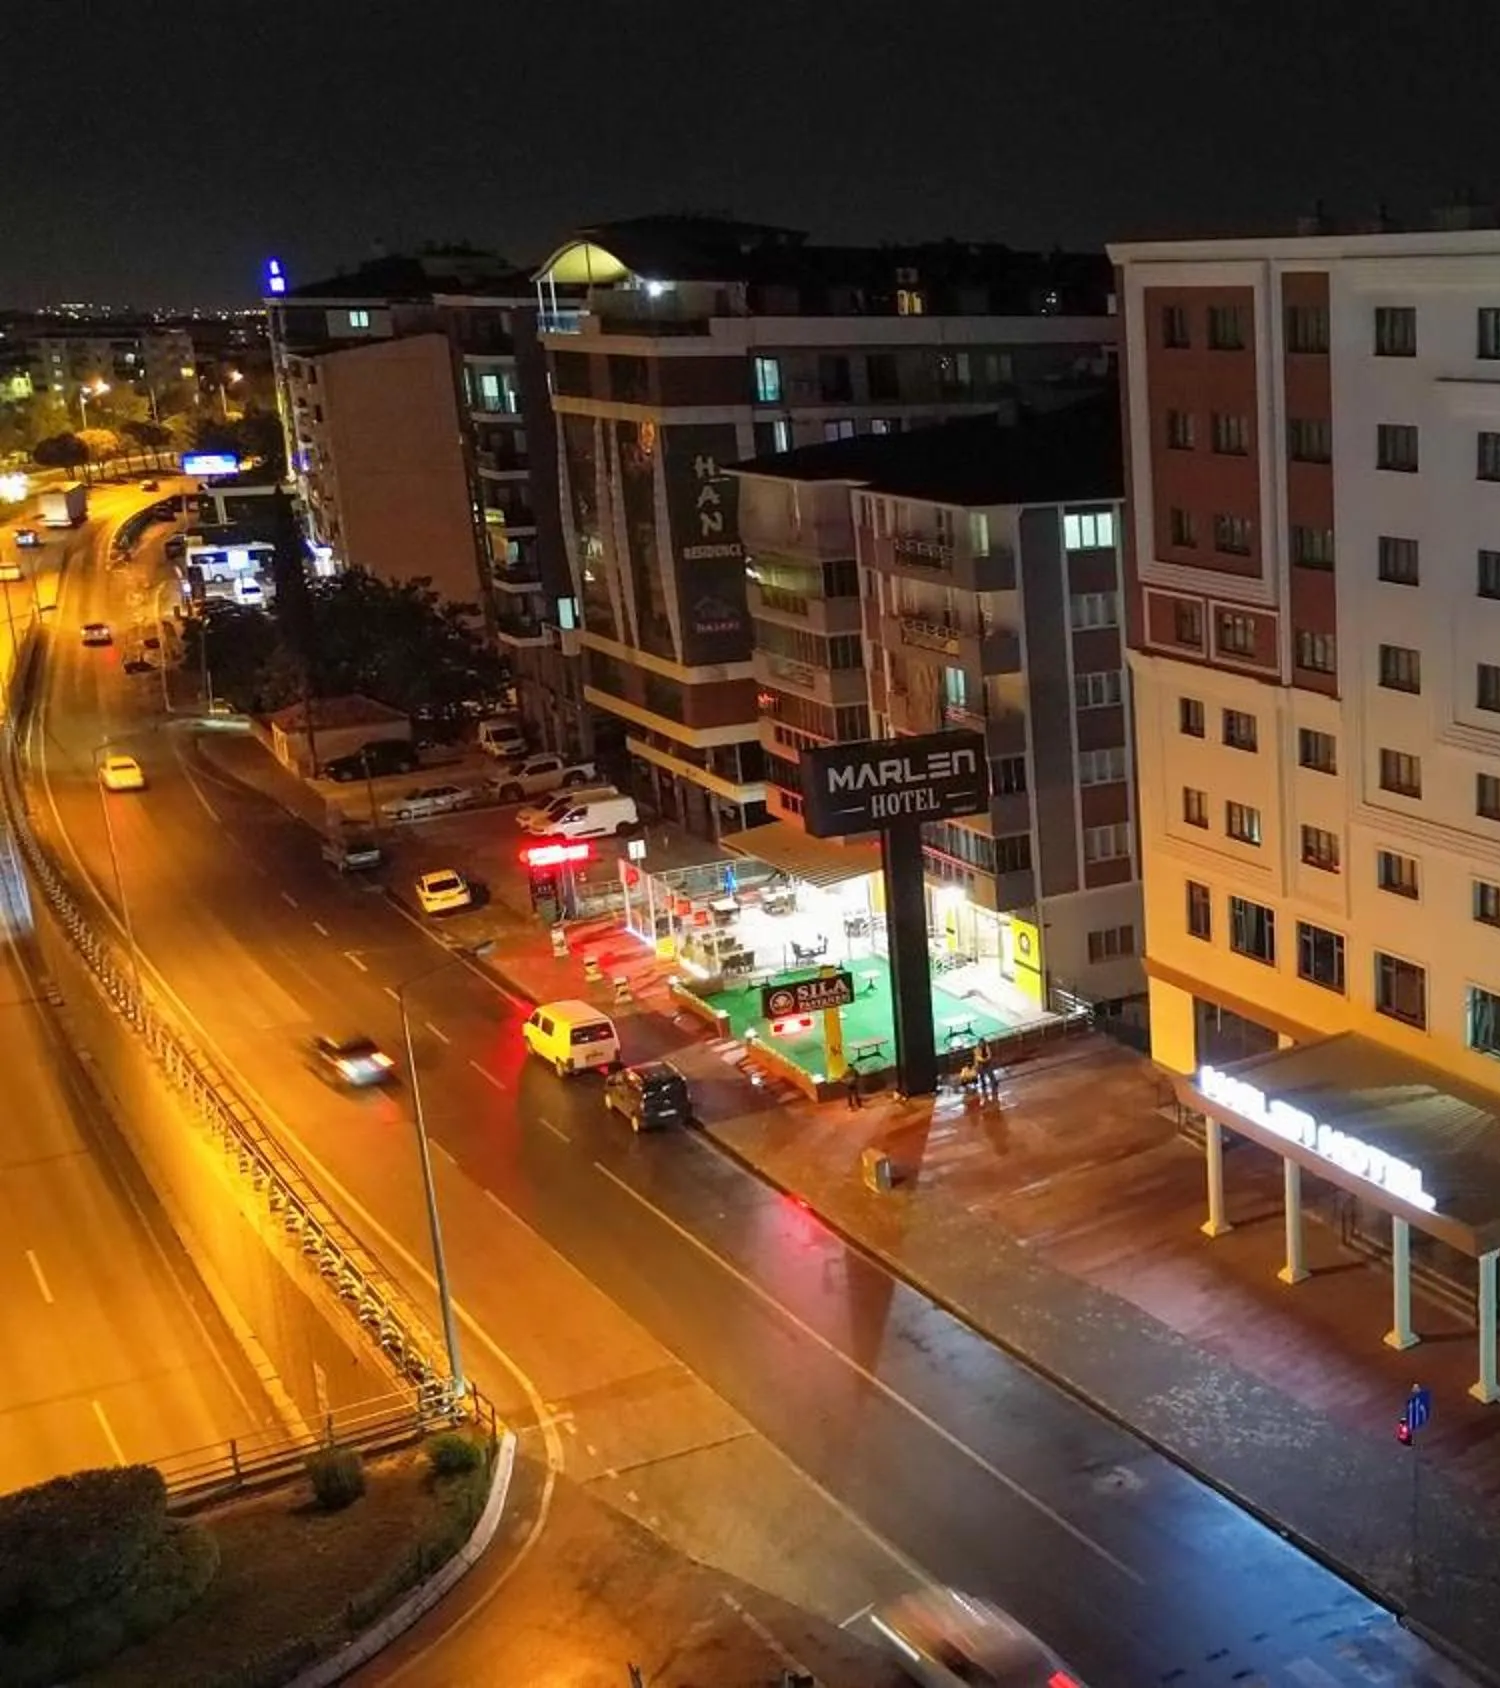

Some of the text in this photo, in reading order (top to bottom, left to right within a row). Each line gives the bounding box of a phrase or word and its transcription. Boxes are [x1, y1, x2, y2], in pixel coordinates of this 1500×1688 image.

[695, 454, 723, 536] HAN
[827, 749, 977, 793] MARLEN
[871, 787, 941, 819] HOTEL
